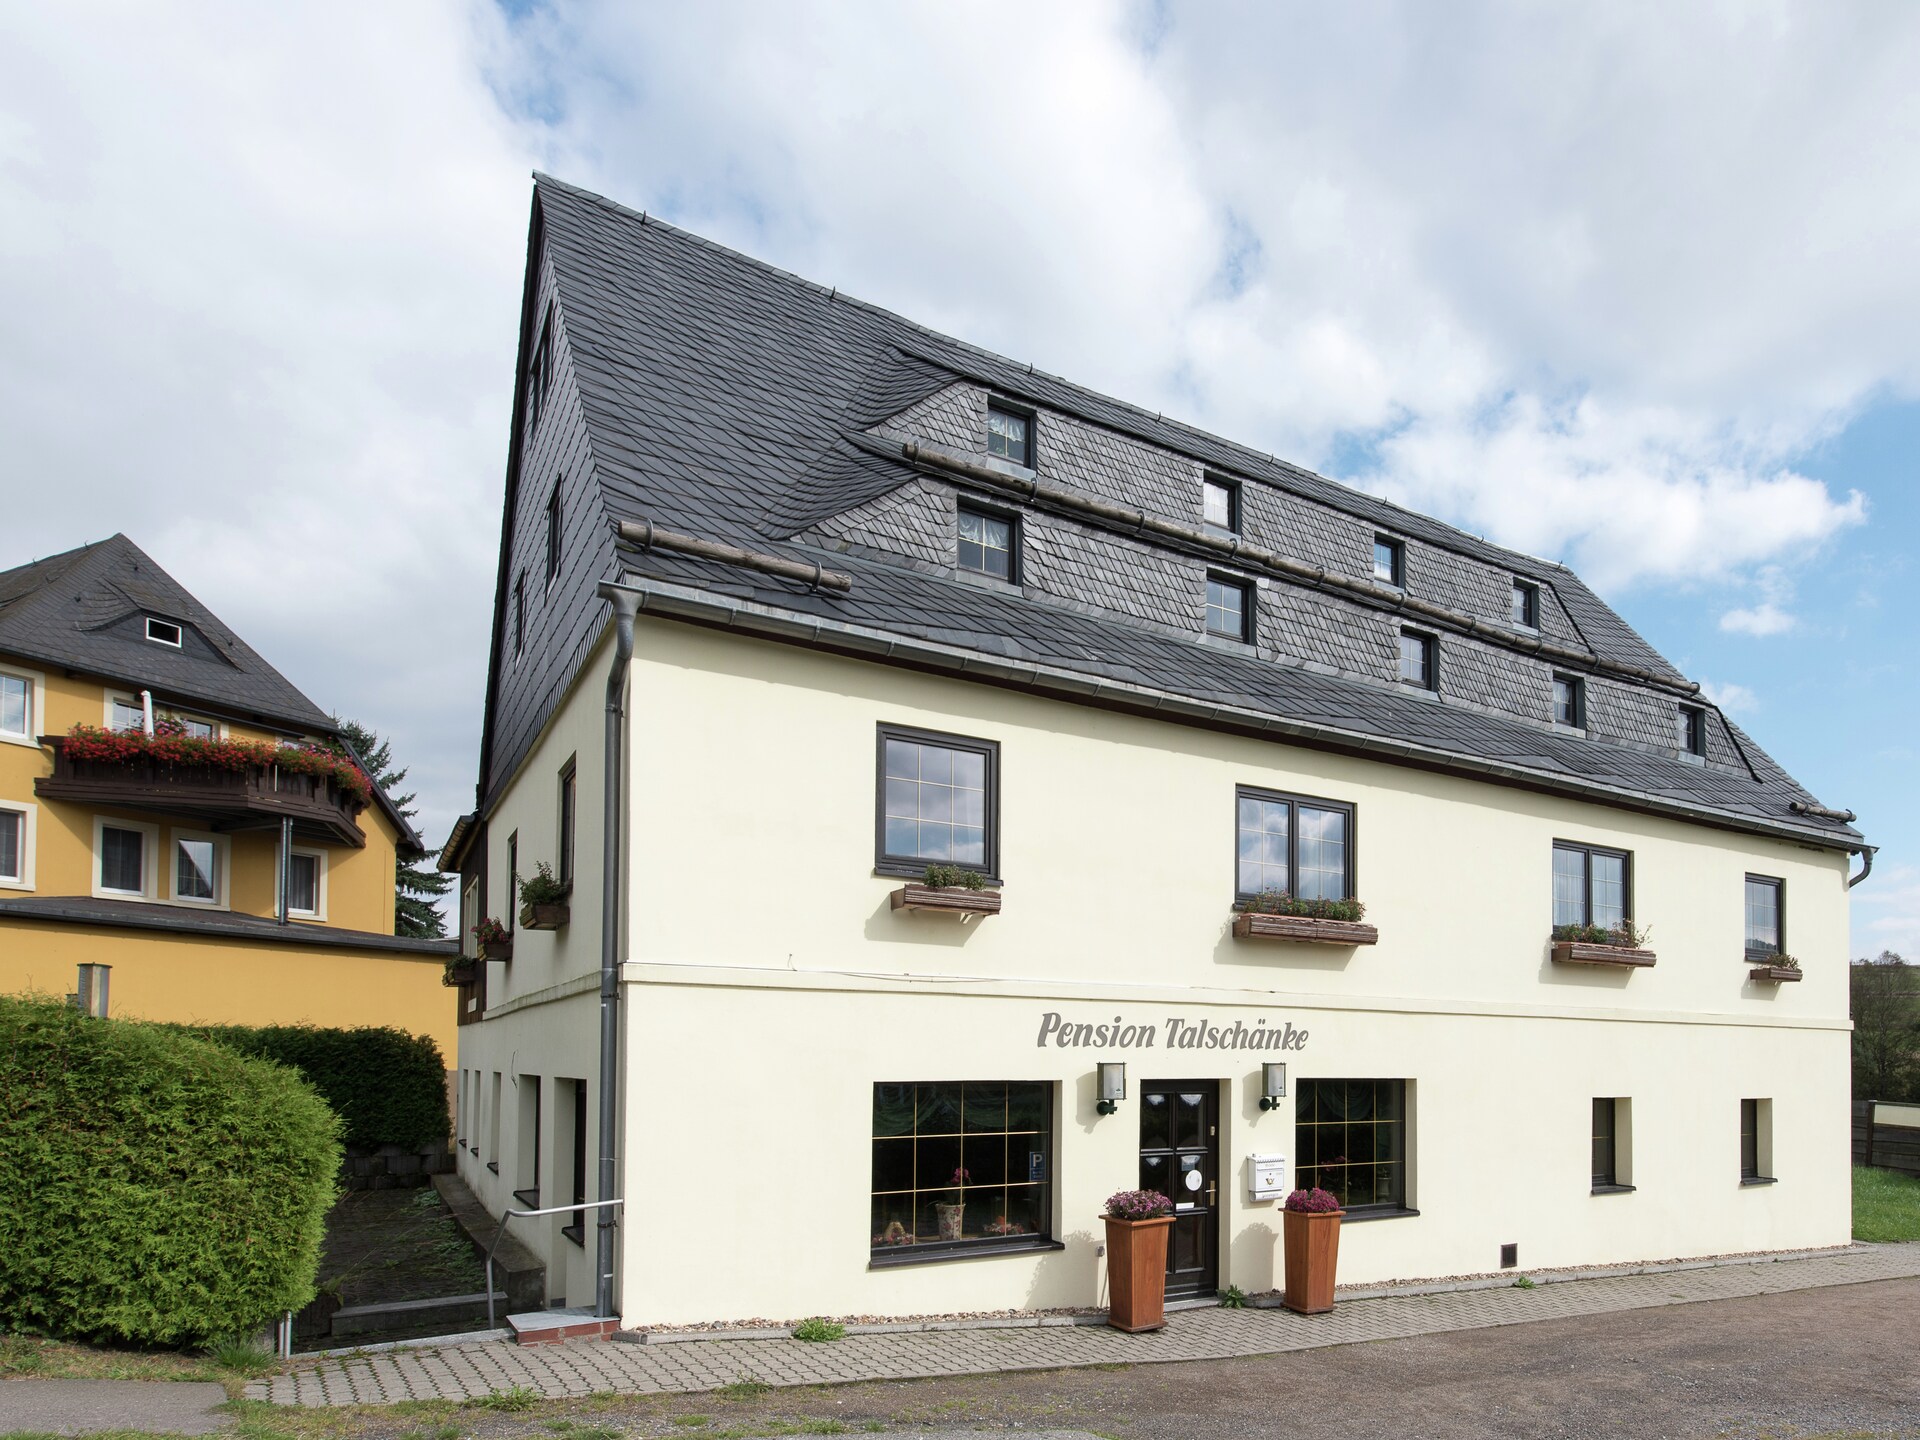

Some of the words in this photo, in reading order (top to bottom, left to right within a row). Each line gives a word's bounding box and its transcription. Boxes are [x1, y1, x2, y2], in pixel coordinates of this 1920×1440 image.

[1037, 1012, 1156, 1048] Pension
[1165, 1018, 1309, 1051] Talschänke
[1033, 1154, 1043, 1168] P
